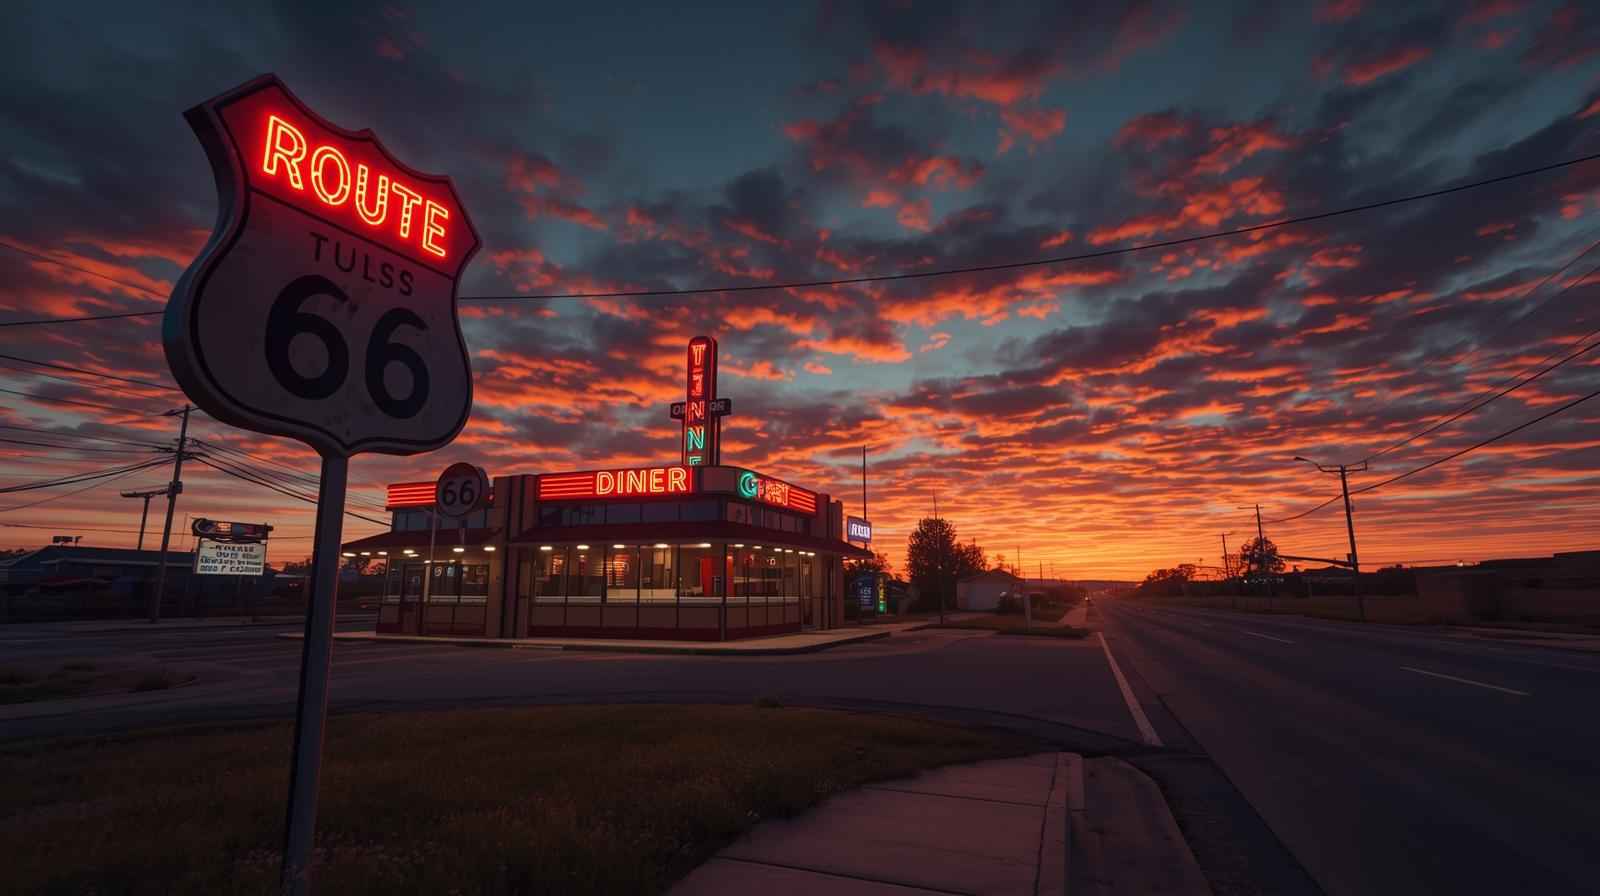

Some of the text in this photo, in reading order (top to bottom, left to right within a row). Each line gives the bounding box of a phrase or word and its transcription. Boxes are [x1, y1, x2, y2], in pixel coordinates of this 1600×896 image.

[263, 115, 449, 257] ROUTE
[309, 231, 416, 297] TULSS
[264, 274, 430, 419] 66
[441, 479, 475, 506] 66
[595, 467, 689, 496] DINER
